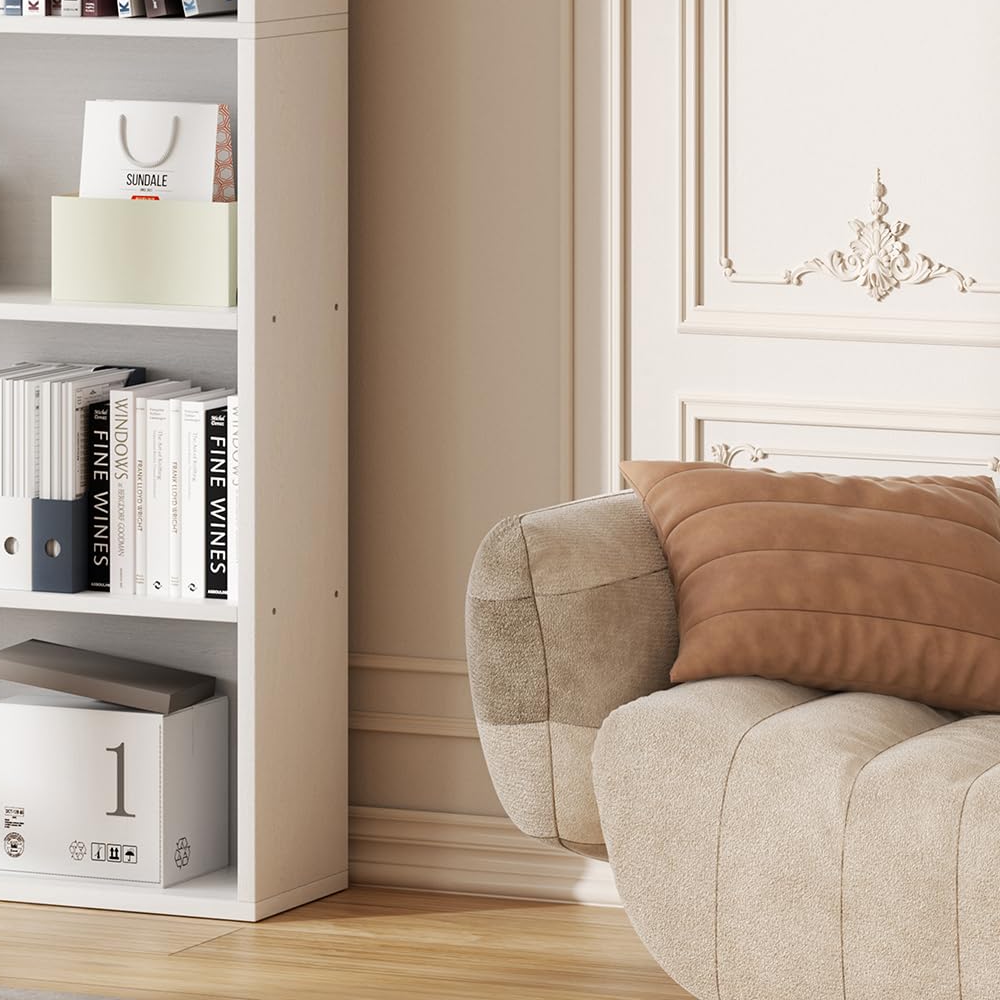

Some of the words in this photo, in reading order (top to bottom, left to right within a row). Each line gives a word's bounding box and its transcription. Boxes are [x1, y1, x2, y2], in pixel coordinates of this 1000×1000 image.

[126, 173, 168, 187] SUNDALE
[93, 430, 109, 481] FINE
[114, 398, 129, 480] WINDOWS
[210, 435, 226, 488] FINE
[93, 491, 109, 566] WINES
[210, 497, 226, 574] WINES
[106, 742, 136, 818] 1
